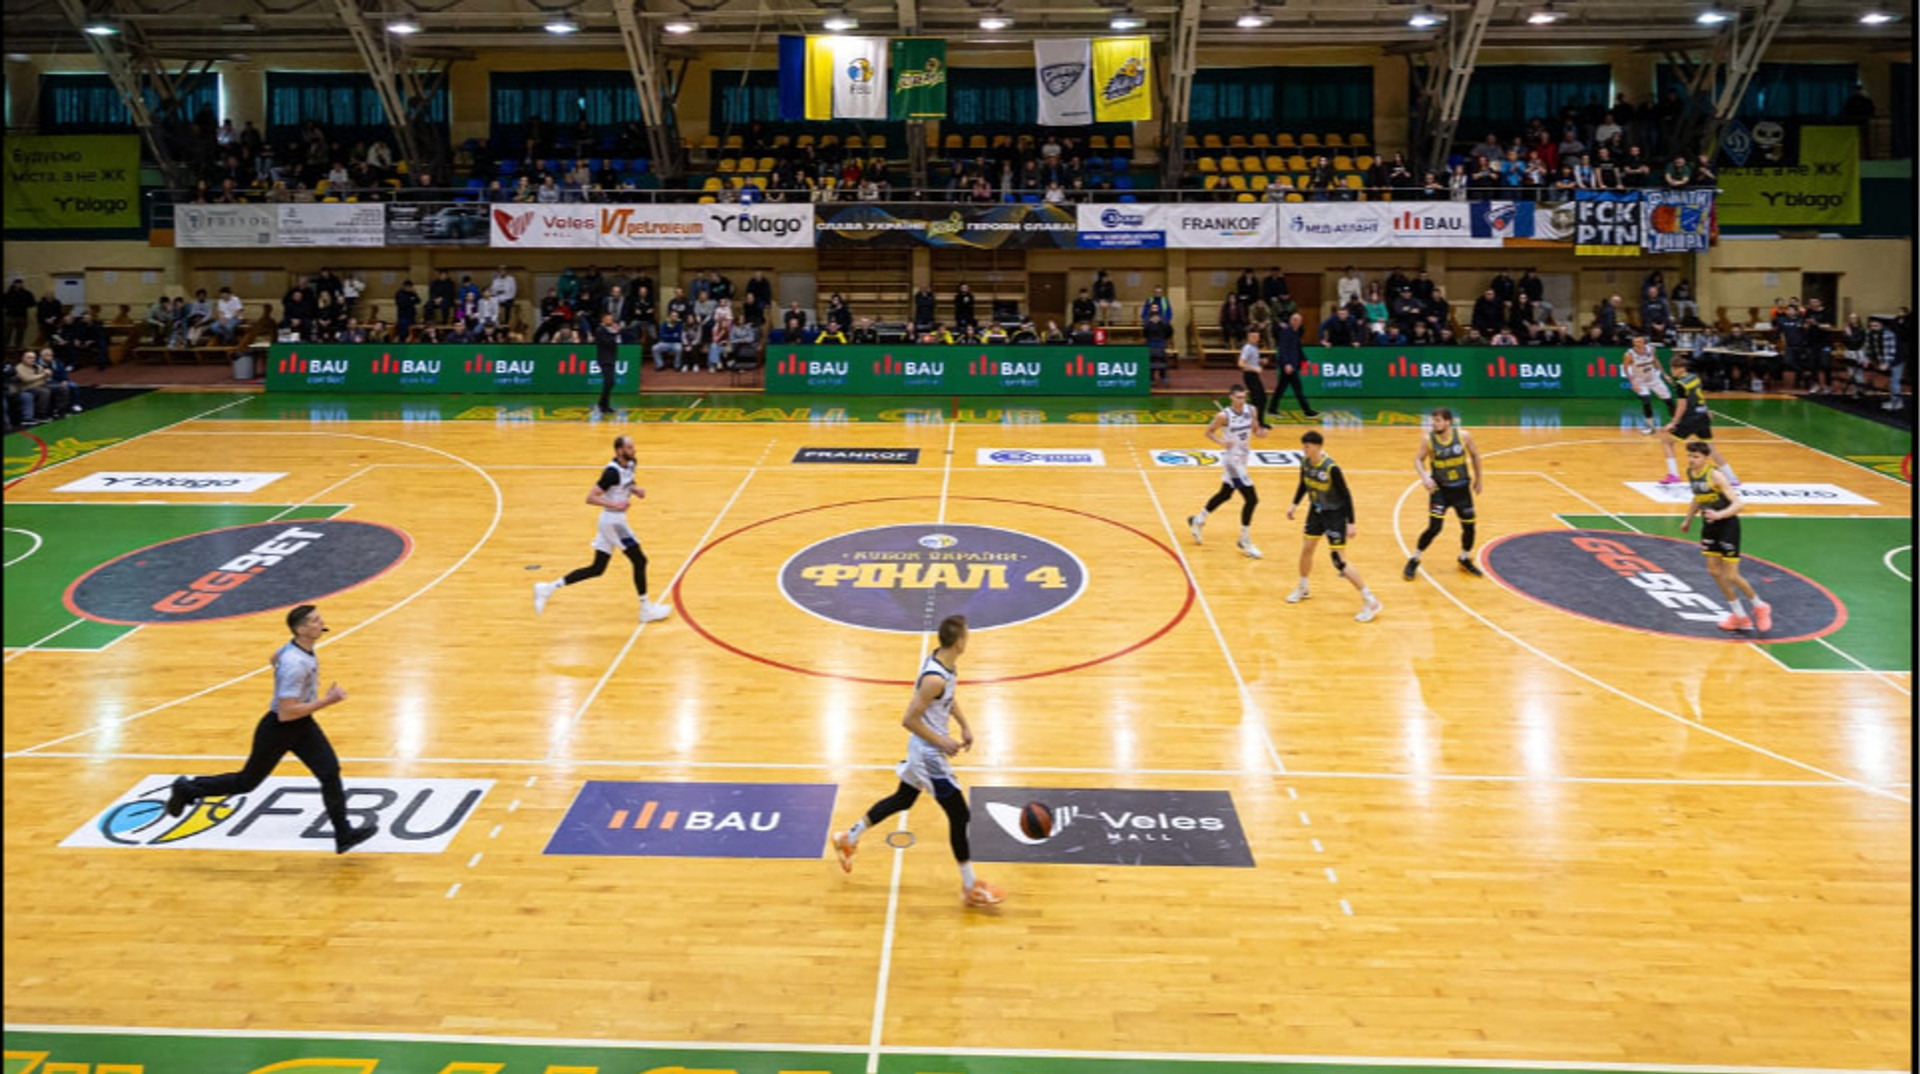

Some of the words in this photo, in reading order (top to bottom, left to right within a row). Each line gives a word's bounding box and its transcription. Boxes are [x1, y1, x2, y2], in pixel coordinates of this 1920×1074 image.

[1579, 201, 1637, 222] FCK
[543, 214, 596, 230] Veles
[1181, 216, 1261, 231] FRANKOF
[1423, 216, 1462, 231] BAU
[1577, 224, 1638, 245] PTN
[309, 360, 349, 374] BAU
[402, 360, 442, 374] BAU
[495, 360, 535, 374] BAU
[589, 360, 629, 374] BU
[809, 361, 849, 375] BAU
[905, 361, 945, 375] BAU
[1001, 362, 1041, 375] BAU
[1097, 362, 1138, 376] BAU
[1322, 363, 1364, 377] BAU
[1421, 363, 1462, 377] BAU
[1520, 364, 1562, 378] BAU
[804, 451, 909, 460] FRANKOF
[152, 527, 325, 614] GG.BET
[801, 562, 1009, 589] ФІНАЛ
[1025, 565, 1068, 589] 4
[226, 786, 483, 841] FBU
[684, 811, 781, 832] BAU
[1099, 811, 1225, 831] Veles
[1107, 832, 1173, 842] MALL
